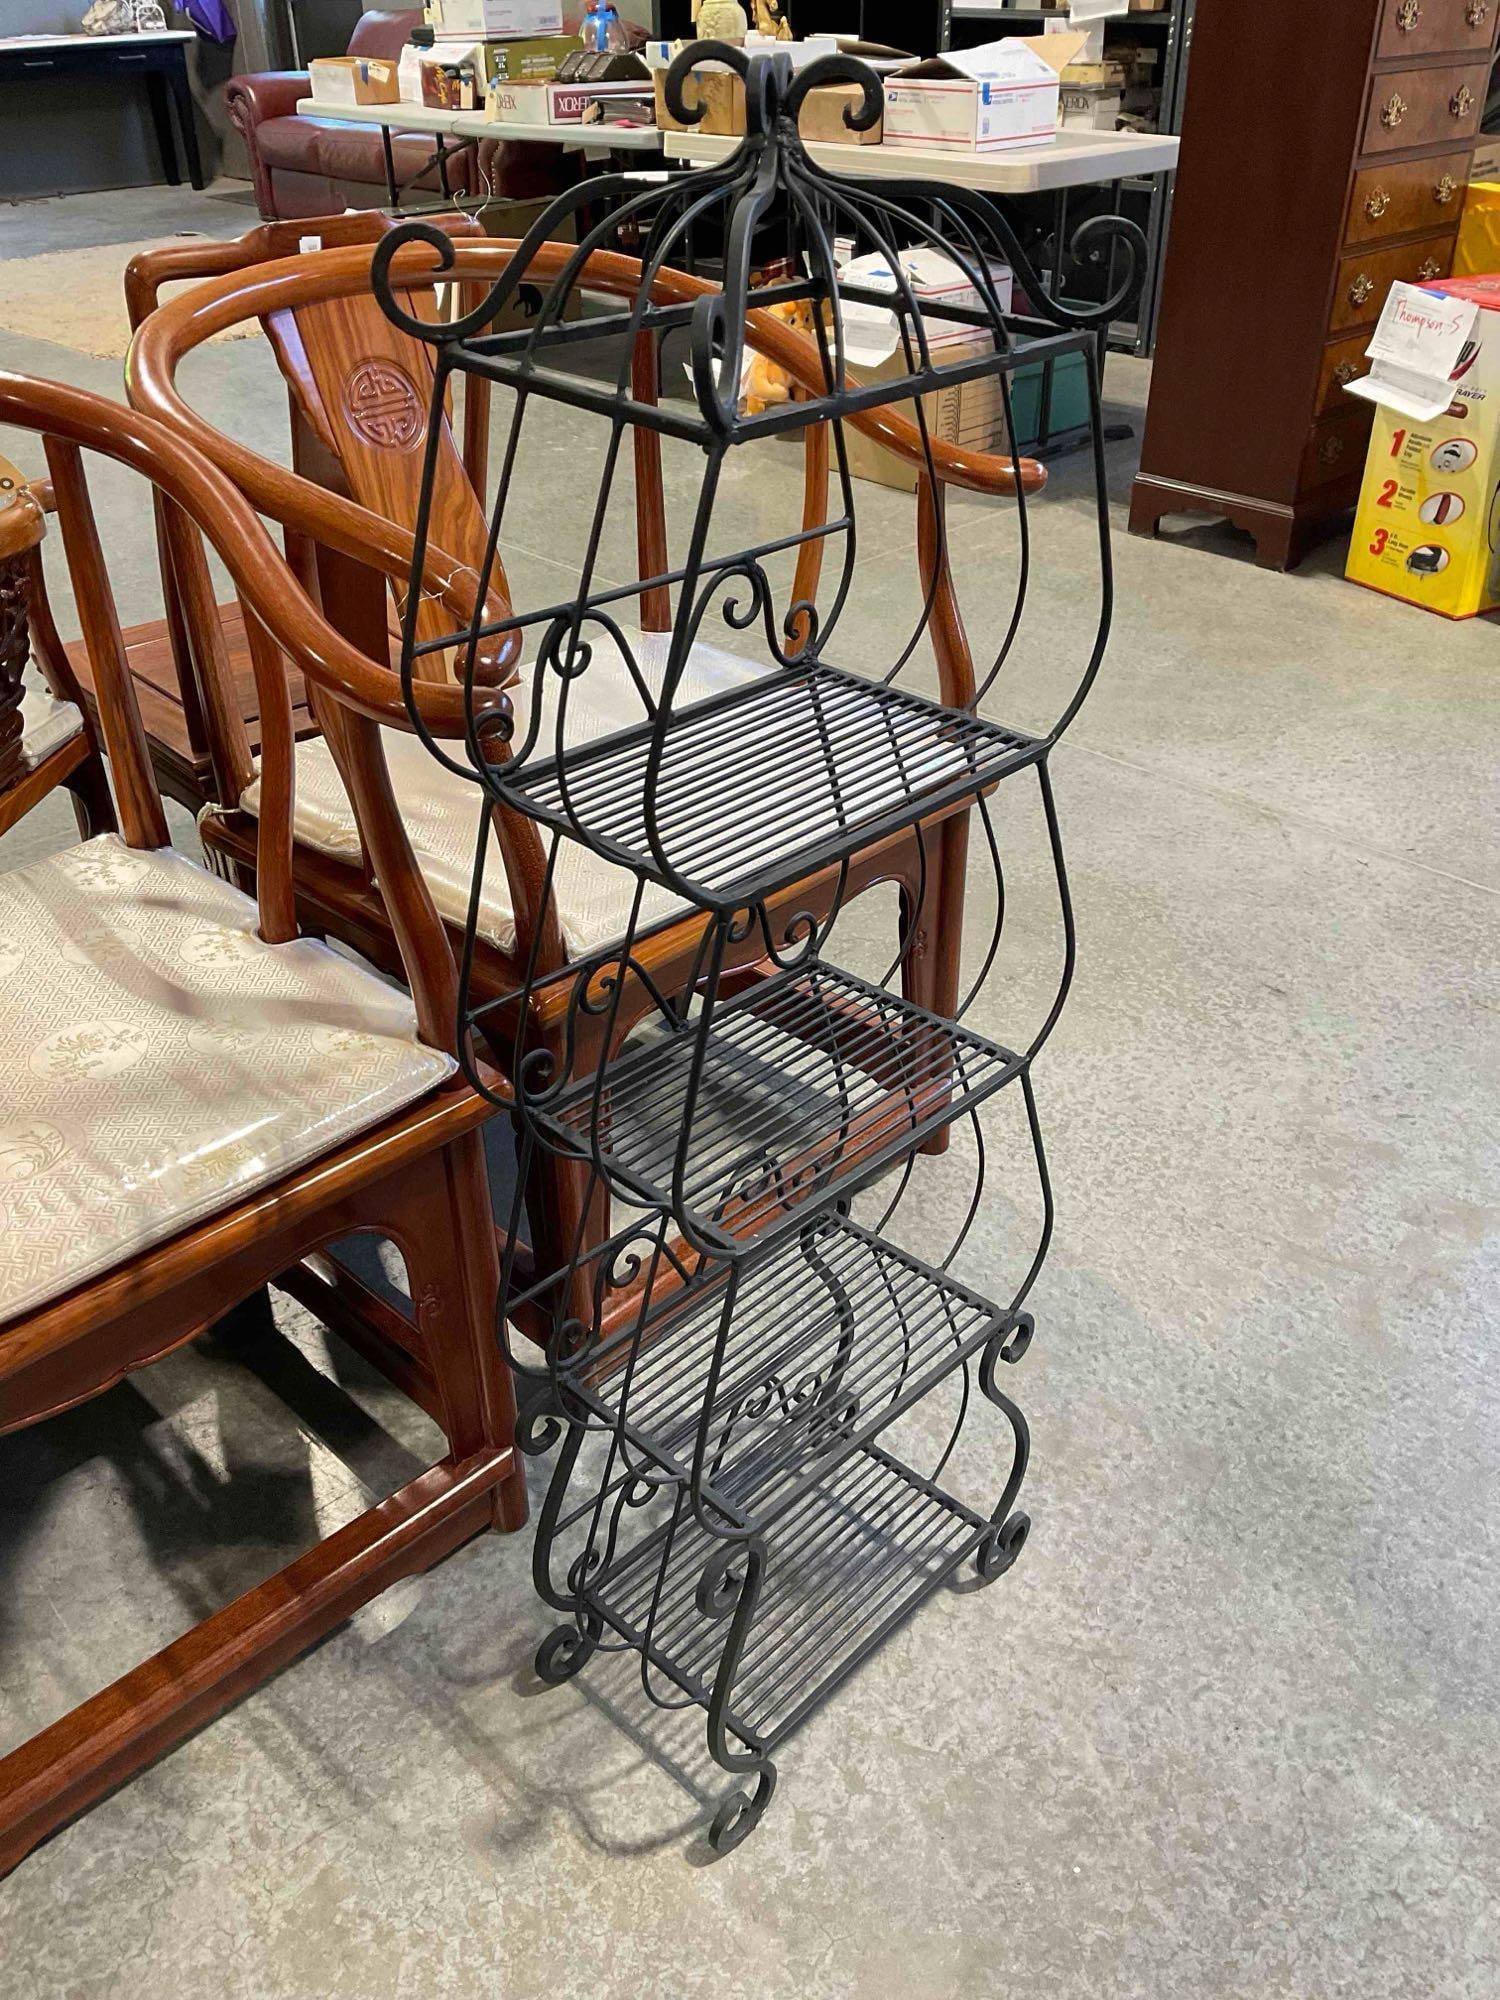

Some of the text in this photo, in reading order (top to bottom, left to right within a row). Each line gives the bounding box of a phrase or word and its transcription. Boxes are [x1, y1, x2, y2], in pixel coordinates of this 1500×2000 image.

[1391, 429, 1406, 457] 1
[1376, 479, 1399, 509] 2
[1369, 528, 1389, 556] 3
